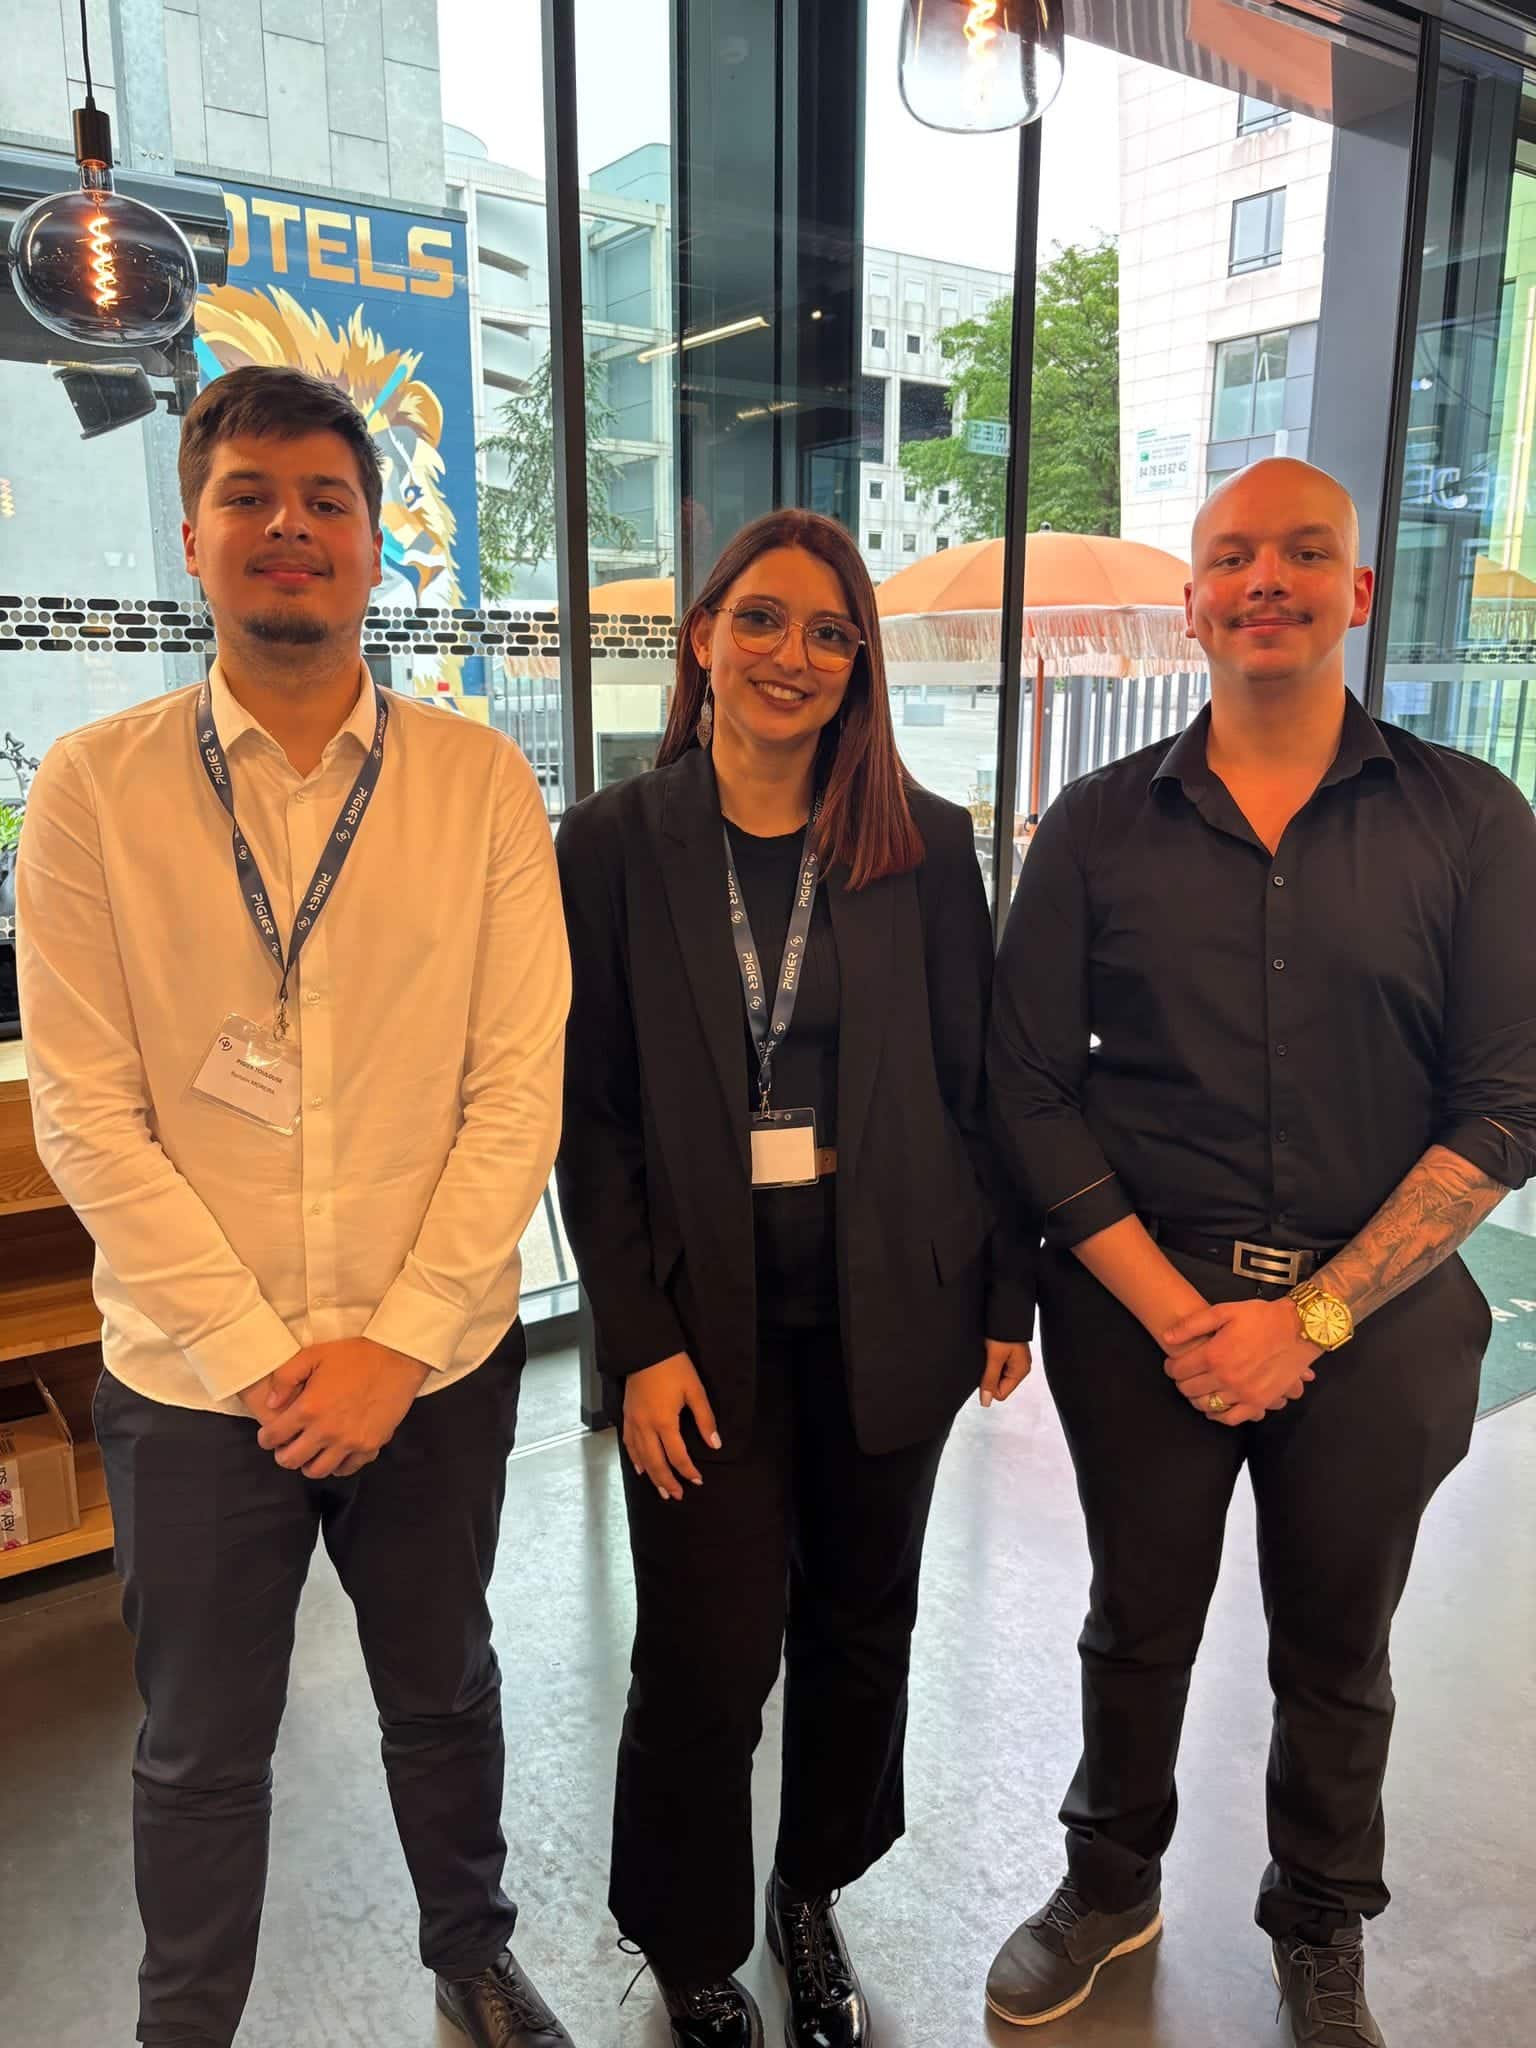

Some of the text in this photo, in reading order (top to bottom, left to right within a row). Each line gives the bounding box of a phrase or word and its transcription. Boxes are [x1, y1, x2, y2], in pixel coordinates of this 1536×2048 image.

[205, 747, 227, 785] PIGIER
[345, 787, 368, 825] PIGIER
[306, 873, 332, 911] PIGIER
[798, 871, 814, 907] PIGIER
[250, 893, 274, 935] PIGIER
[742, 952, 758, 990] PIGIER
[783, 952, 798, 990] PIGIER
